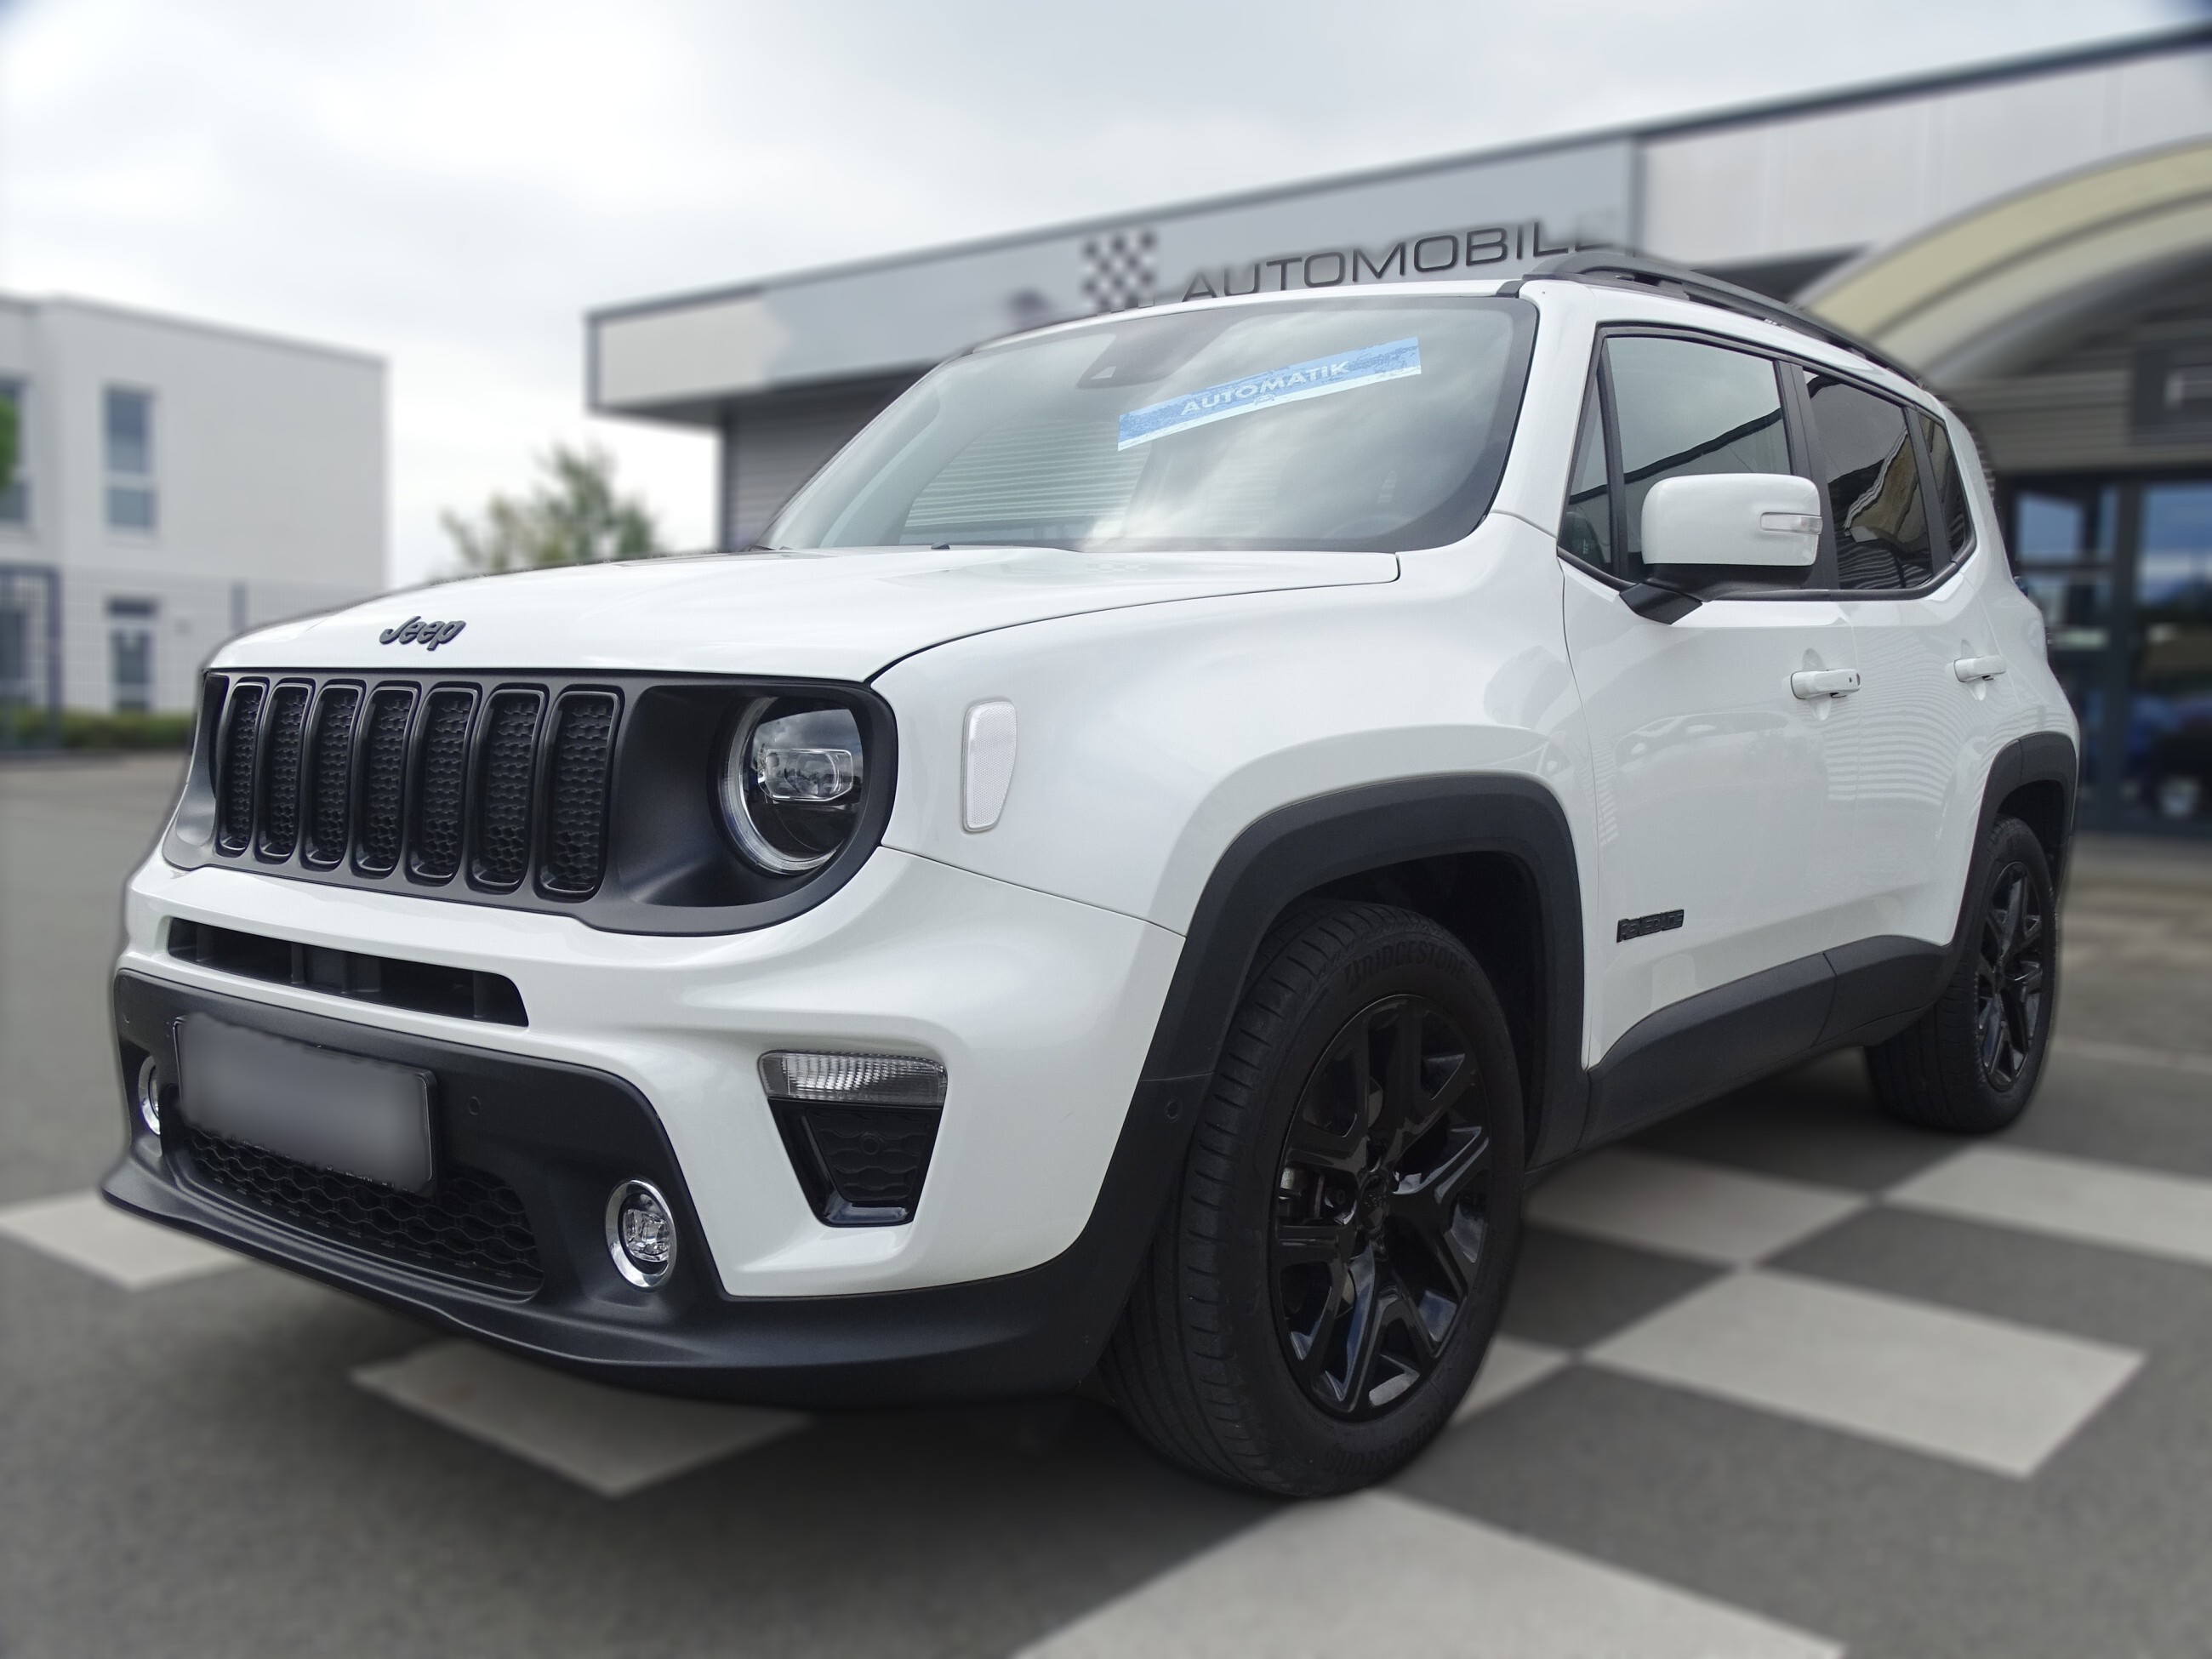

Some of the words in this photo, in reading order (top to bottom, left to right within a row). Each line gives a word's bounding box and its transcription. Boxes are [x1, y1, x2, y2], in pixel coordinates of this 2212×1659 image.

[1180, 361, 1349, 415] AUTOMATIK
[379, 616, 466, 651] Jeep
[1345, 939, 1470, 995] BRIDGESTONE
